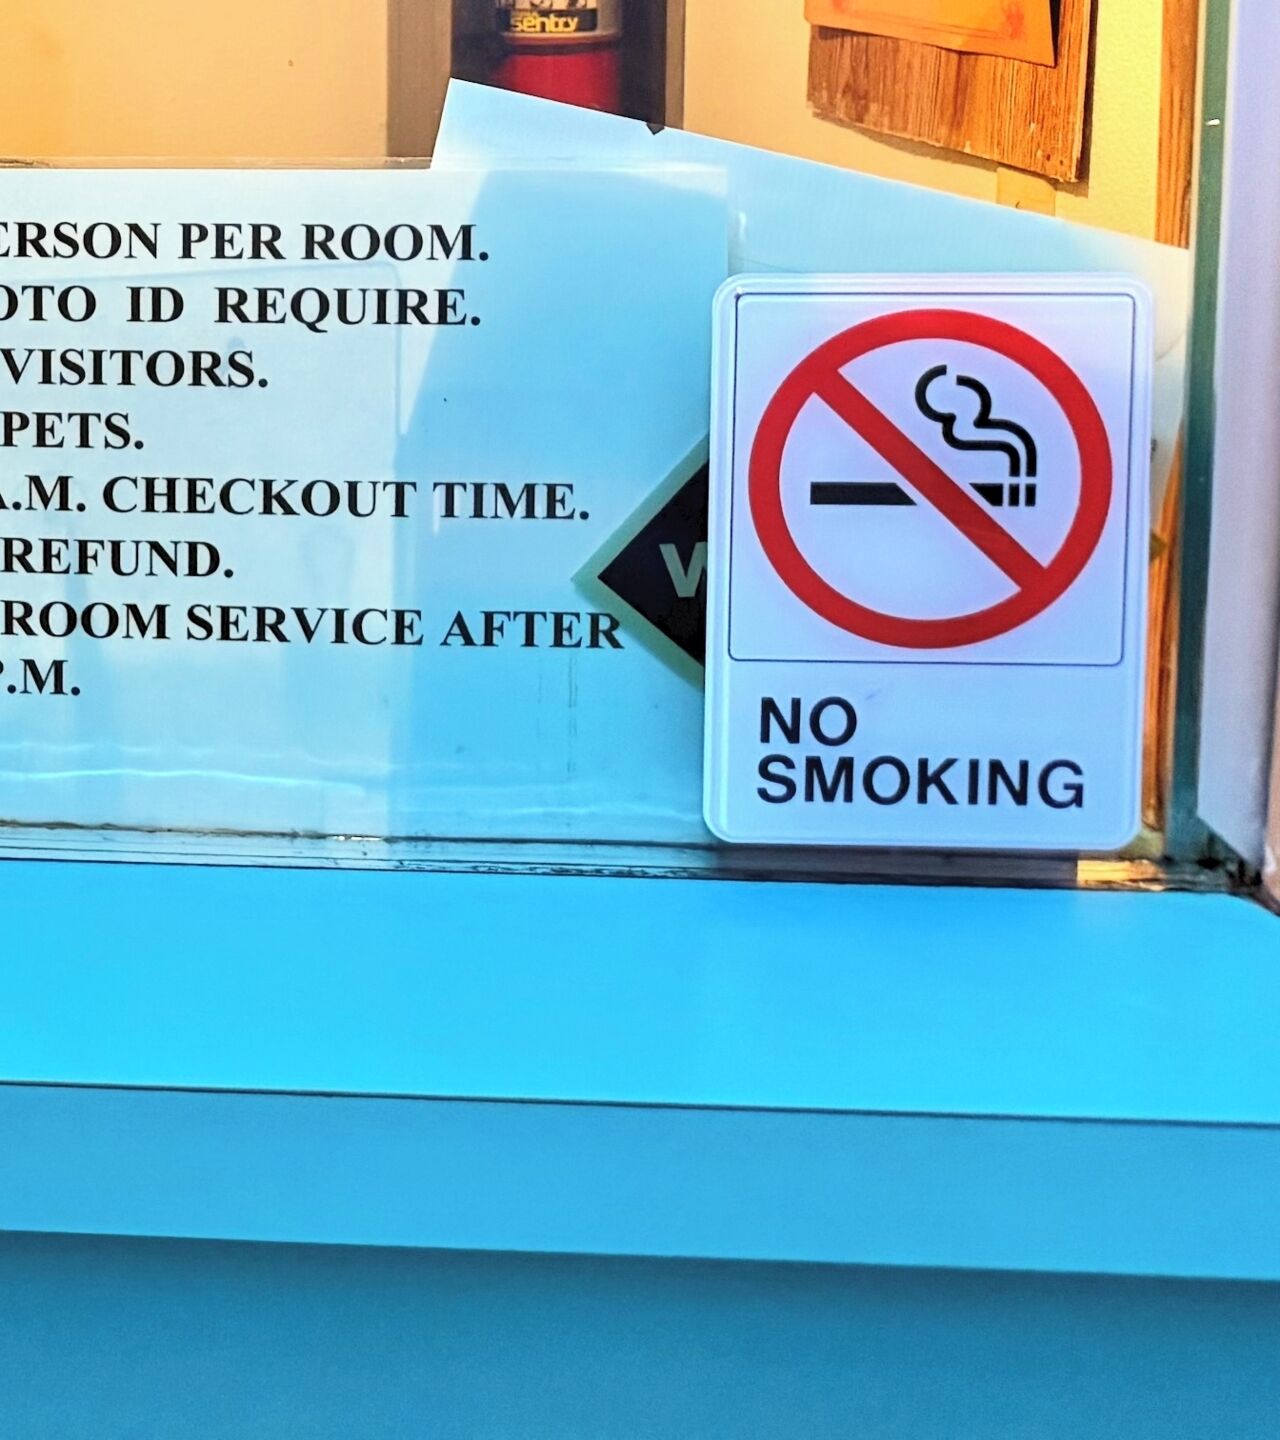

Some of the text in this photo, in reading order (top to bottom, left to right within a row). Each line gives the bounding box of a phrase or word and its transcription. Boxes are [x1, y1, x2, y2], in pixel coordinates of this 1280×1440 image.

[511, 13, 578, 33] sentry
[179, 223, 286, 260] PER
[303, 224, 490, 261] ROOM.
[126, 286, 184, 323] ID
[214, 287, 482, 333] REQUIRE.
[0, 348, 269, 388] VISITORS.
[0, 411, 145, 449] PETS.
[102, 476, 417, 518] CHECKOUT
[432, 482, 590, 520] TIME.
[1, 537, 234, 577] REFUND.
[1, 599, 170, 640] ROOM
[186, 604, 424, 646] SERVICE
[439, 610, 625, 649] AFTER
[759, 696, 858, 747] NO
[756, 754, 1085, 810] SMOKING
